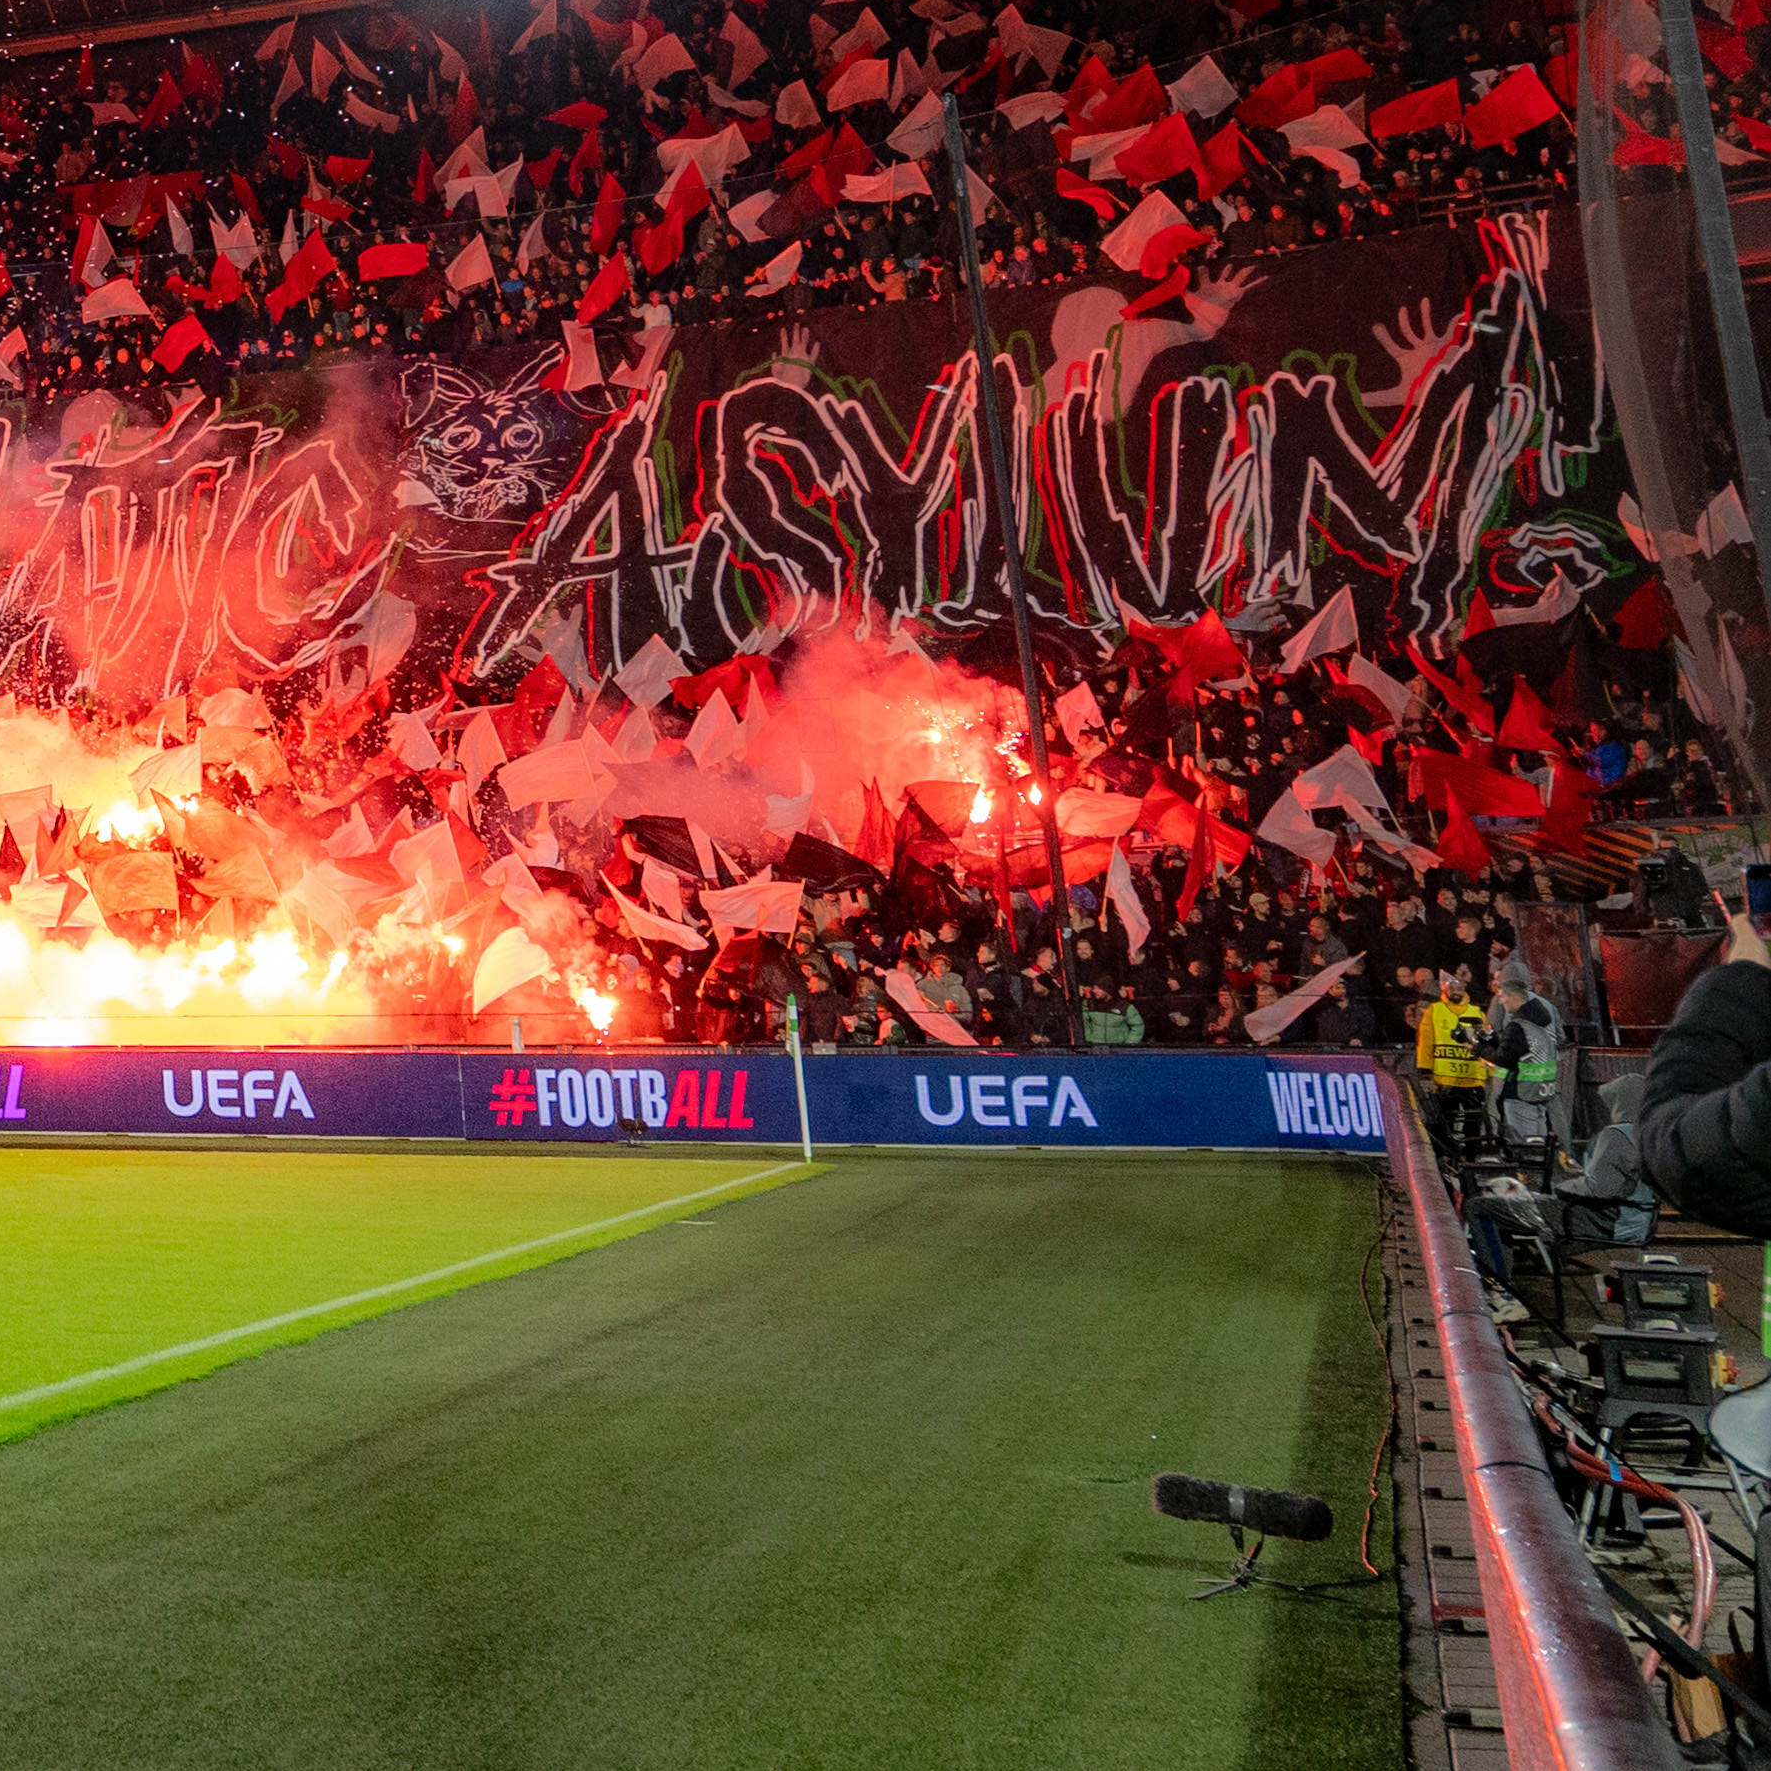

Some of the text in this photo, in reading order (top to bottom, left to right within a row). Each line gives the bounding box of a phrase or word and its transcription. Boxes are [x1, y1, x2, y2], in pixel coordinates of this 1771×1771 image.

[1449, 1061, 1470, 1074] 317
[161, 1069, 316, 1119] UEFA
[488, 1068, 754, 1129] #FOOTBALL
[914, 1075, 1099, 1128] UEFA
